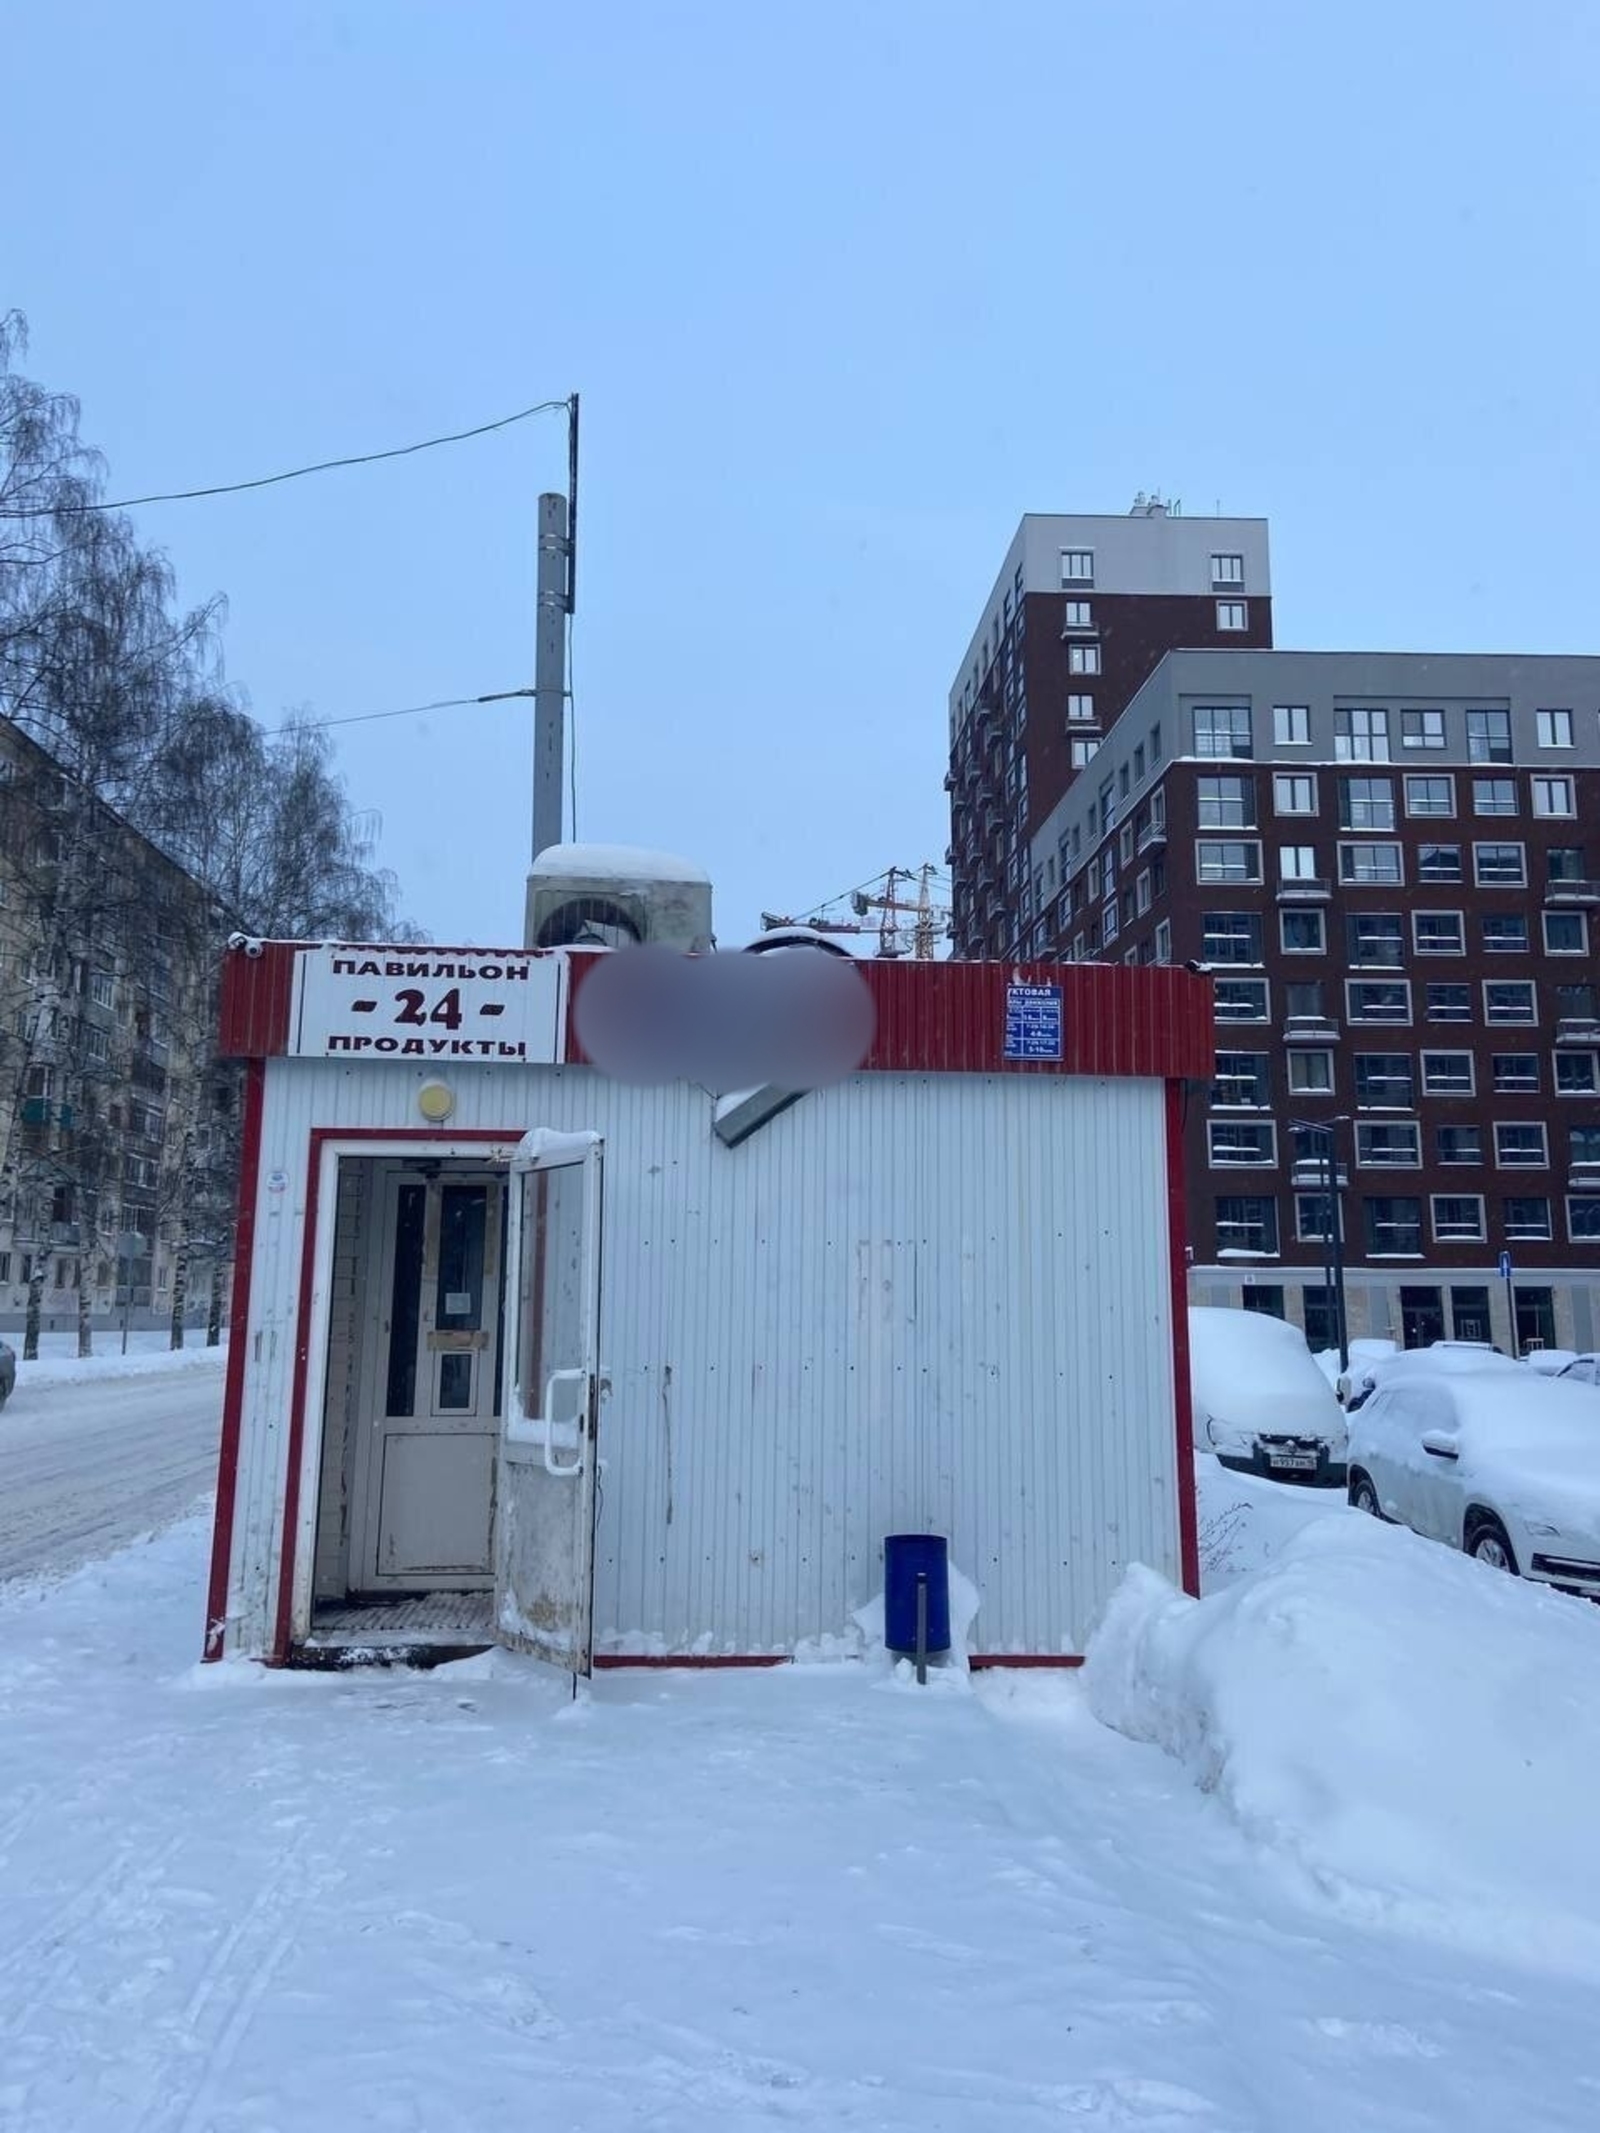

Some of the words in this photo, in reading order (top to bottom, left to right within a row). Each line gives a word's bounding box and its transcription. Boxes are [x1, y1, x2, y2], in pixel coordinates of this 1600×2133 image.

[333, 959, 529, 980] ПАВИЛЬОН
[394, 988, 463, 1030] 24
[328, 1036, 527, 1057] ПРОДУКТЫ
